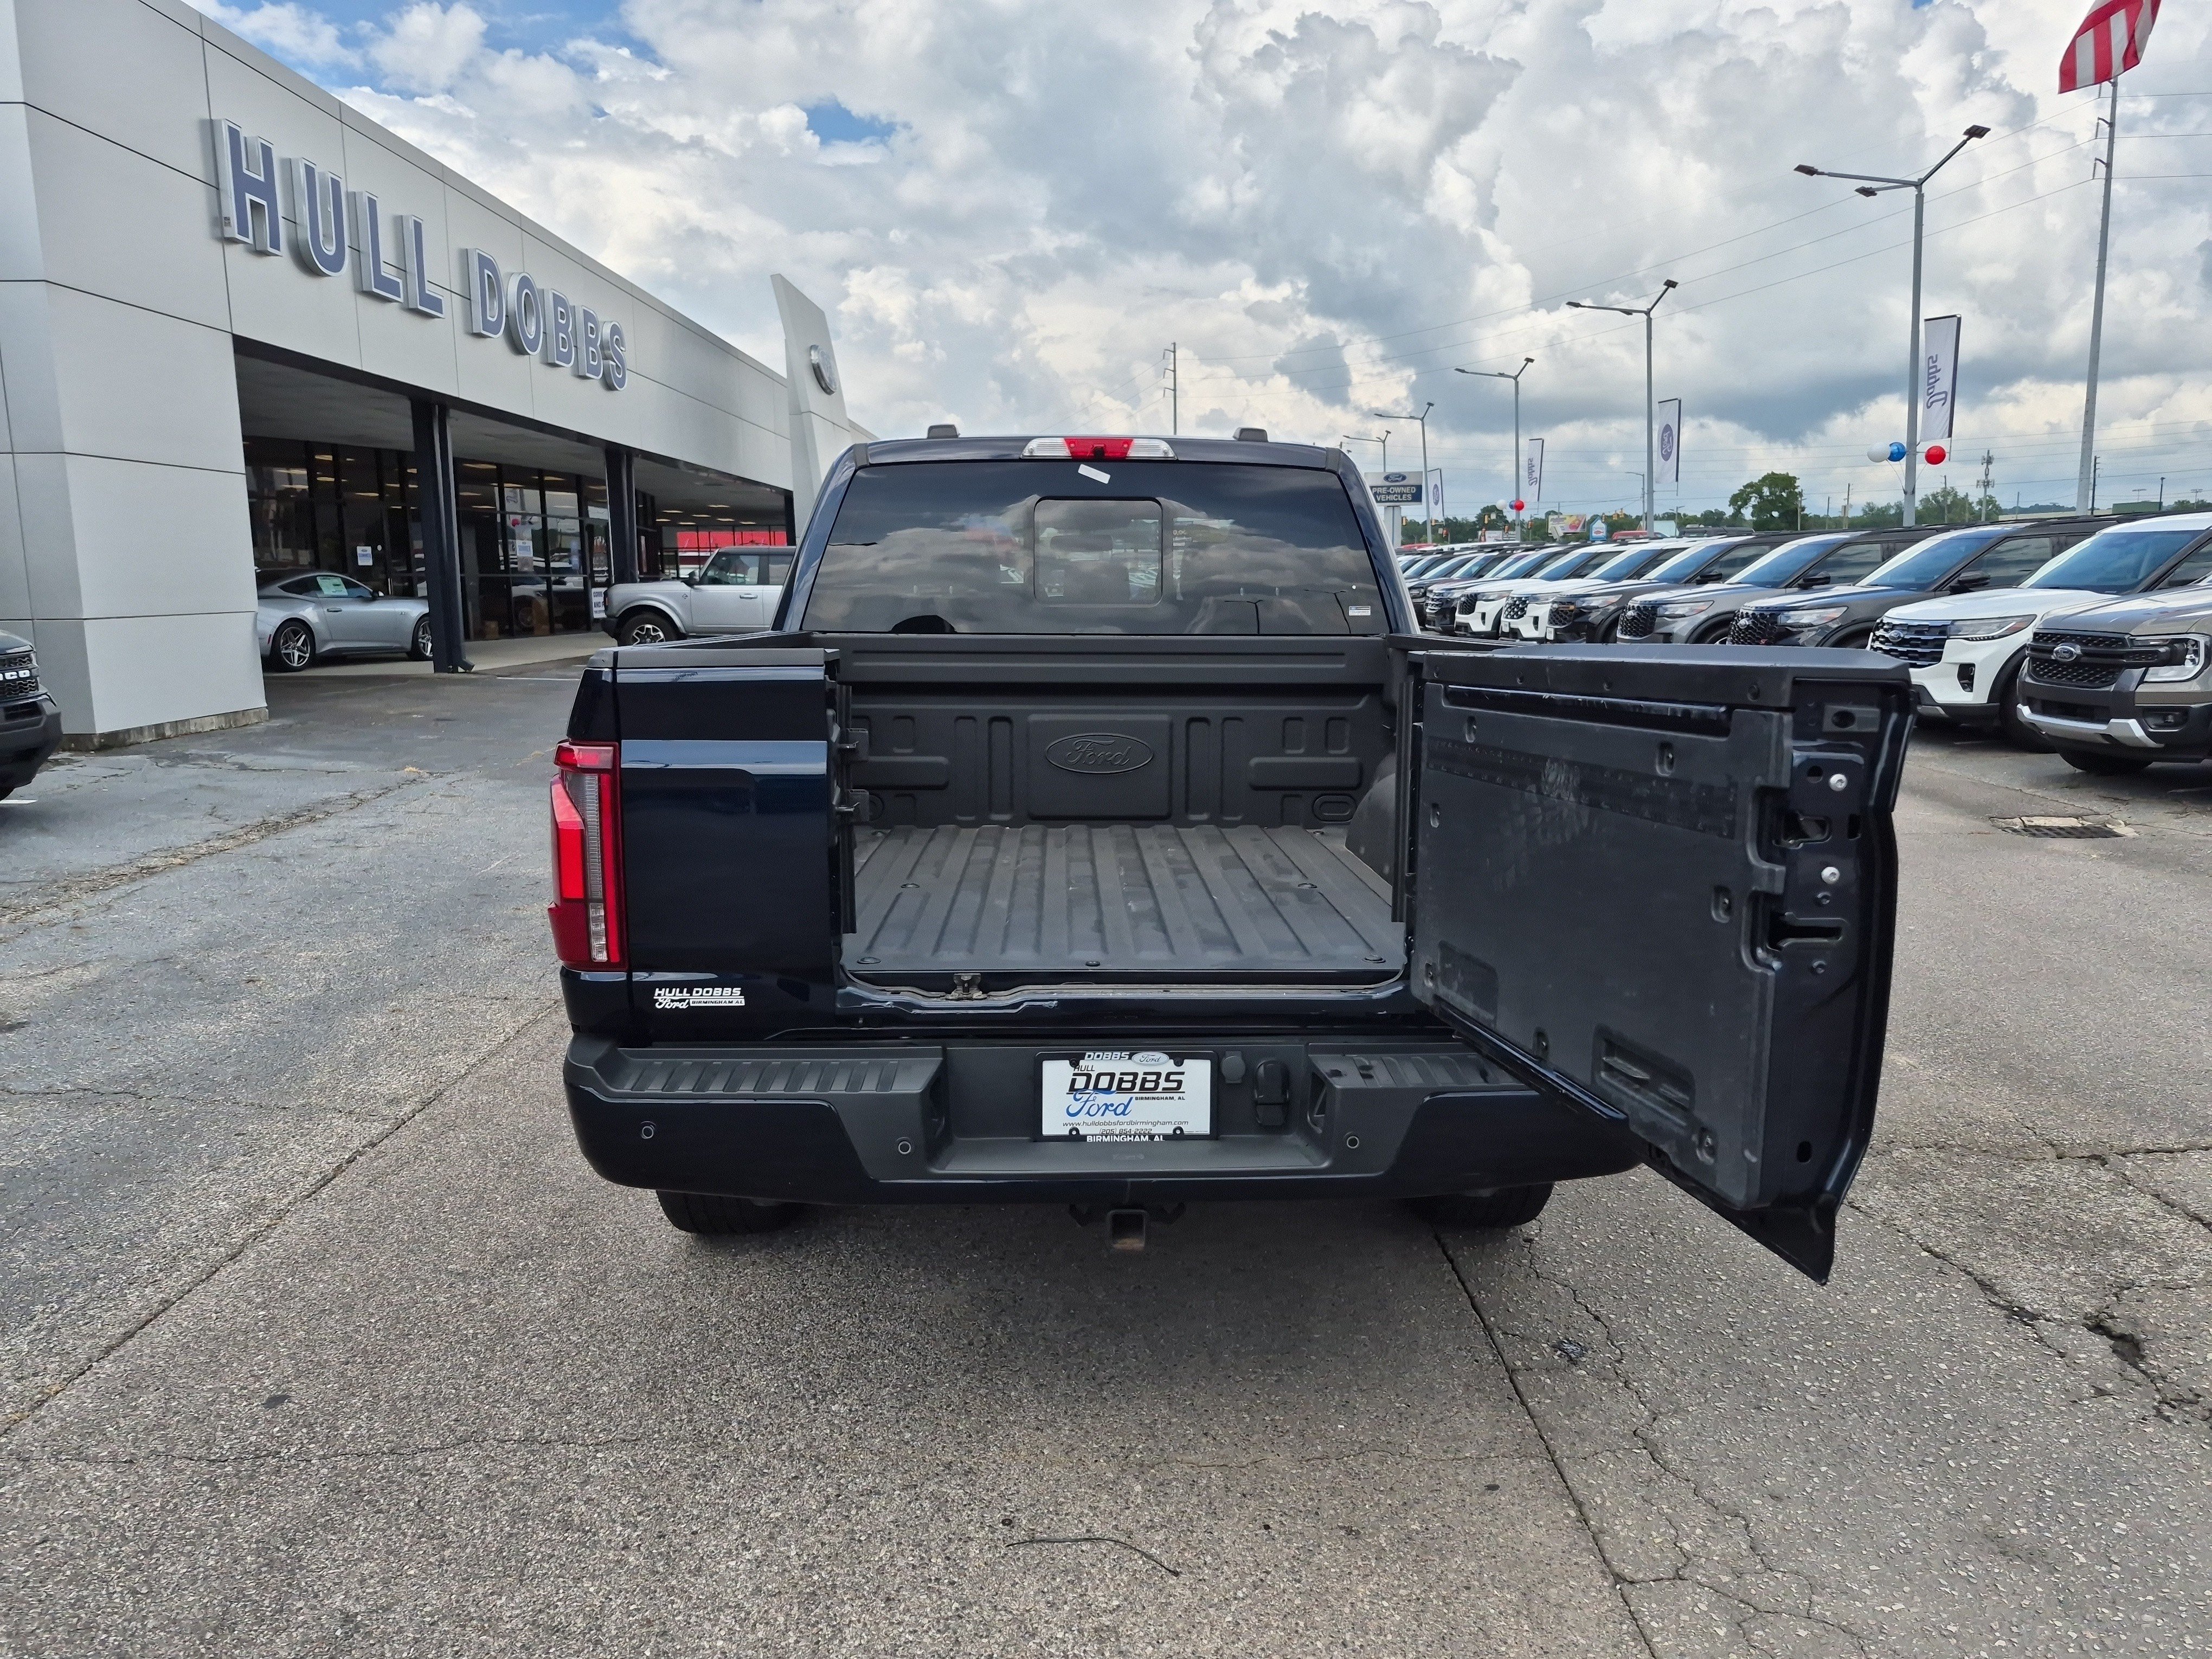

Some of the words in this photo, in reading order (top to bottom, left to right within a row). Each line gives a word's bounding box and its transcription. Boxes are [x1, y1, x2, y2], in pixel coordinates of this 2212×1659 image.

[214, 119, 445, 319] HULL
[467, 247, 628, 391] DOBBS
[1372, 486, 1416, 494] PRE-OWNED
[1066, 738, 1131, 766] Ford
[654, 988, 690, 996] HULL
[692, 987, 742, 996] DOBBS
[655, 997, 689, 1009] Ford
[1084, 1052, 1130, 1060] DOBBS
[1139, 1054, 1161, 1063] Ford
[1068, 1071, 1185, 1092] DOBBS
[1066, 1089, 1133, 1117] Ford
